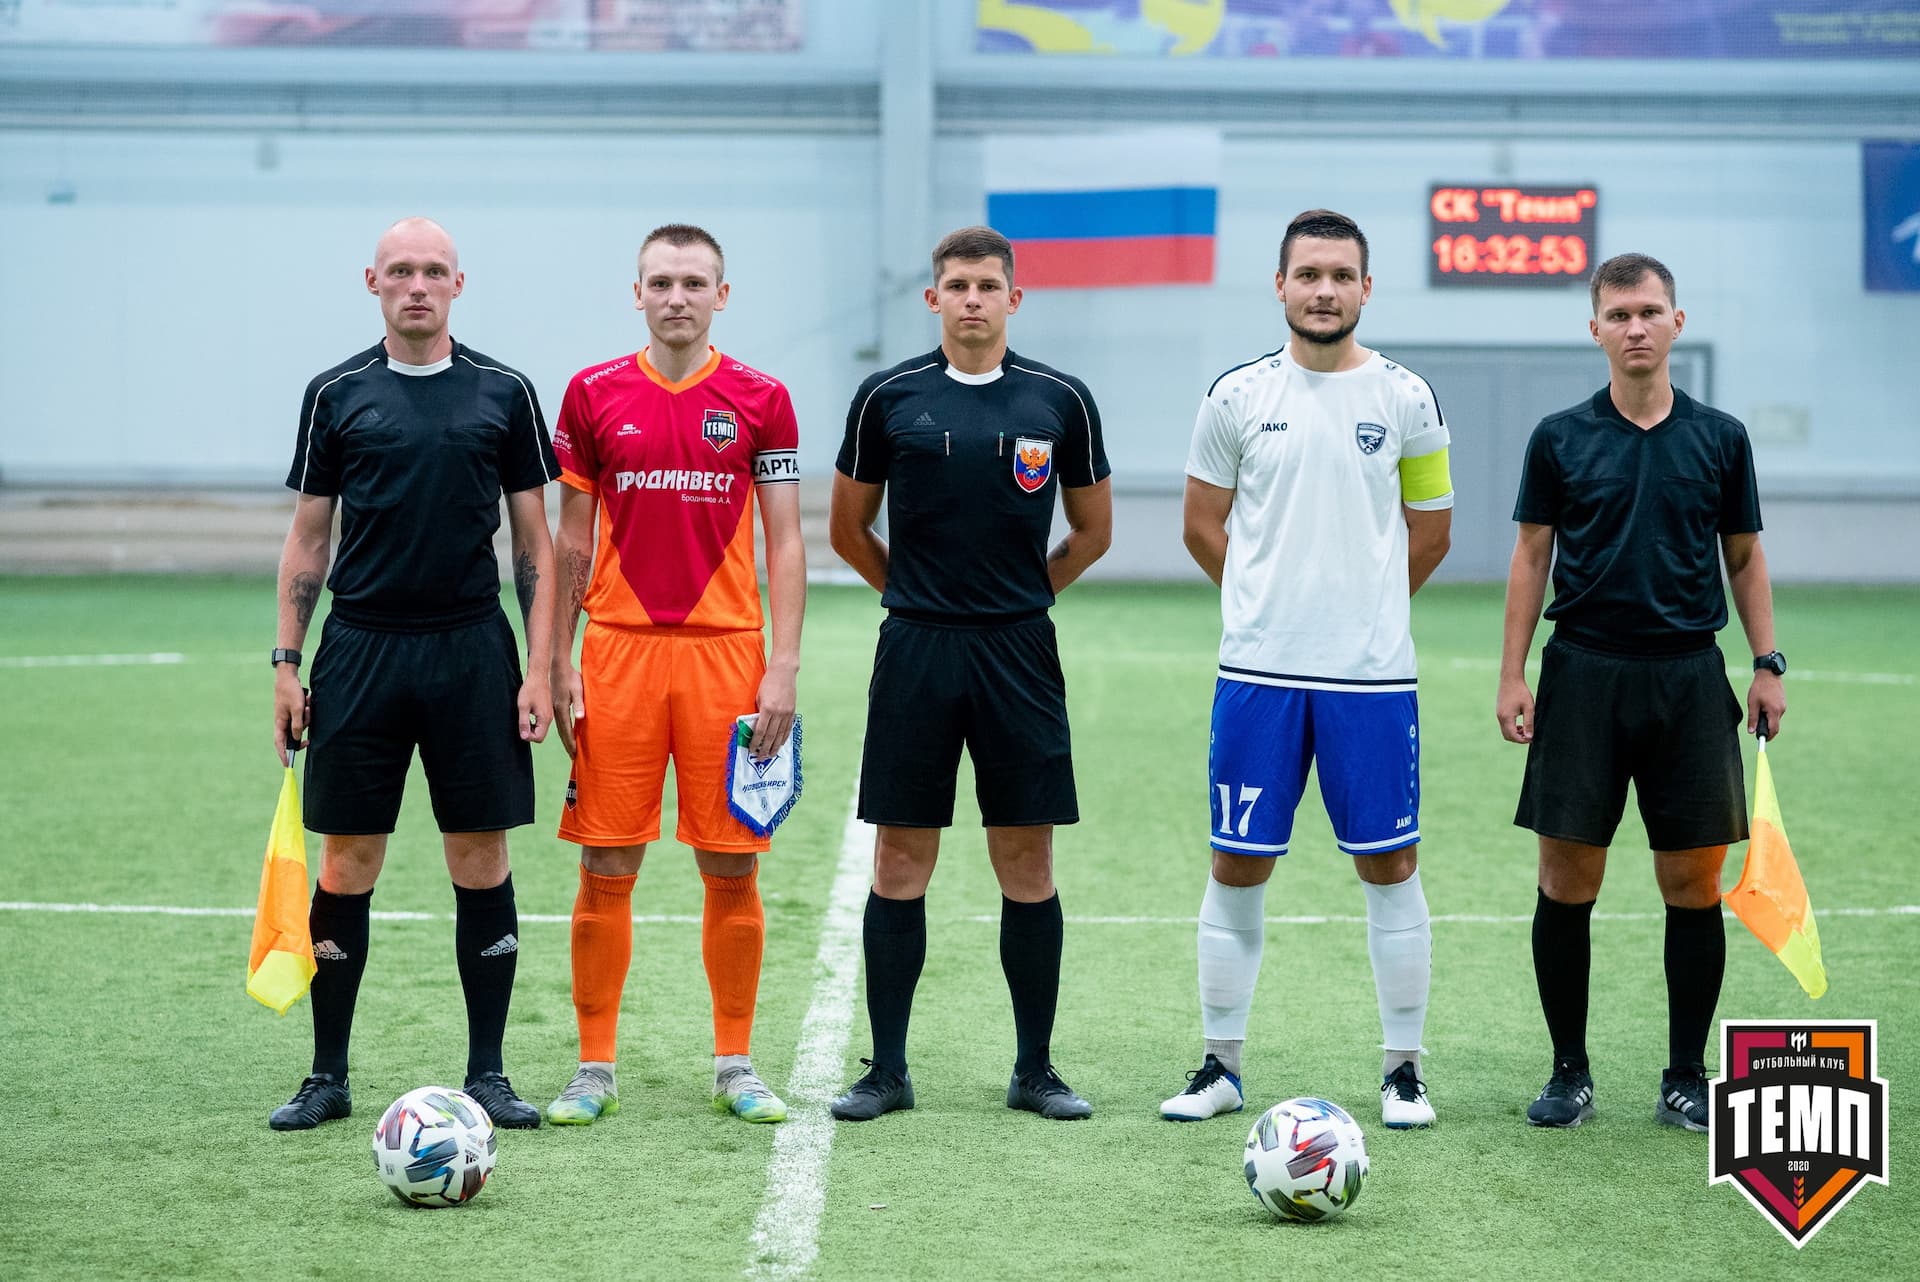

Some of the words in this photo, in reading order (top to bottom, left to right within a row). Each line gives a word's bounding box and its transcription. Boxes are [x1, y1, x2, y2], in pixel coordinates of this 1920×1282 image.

[1431, 188, 1480, 222] СК
[1432, 234, 1587, 274] 16:32:53
[706, 421, 735, 438] ТЕМП
[1260, 422, 1288, 433] JAKO
[615, 470, 735, 494] ПРОДИНВЕСТ
[1216, 783, 1263, 838] 17
[1395, 814, 1412, 830] JAKO
[313, 949, 348, 960] didas
